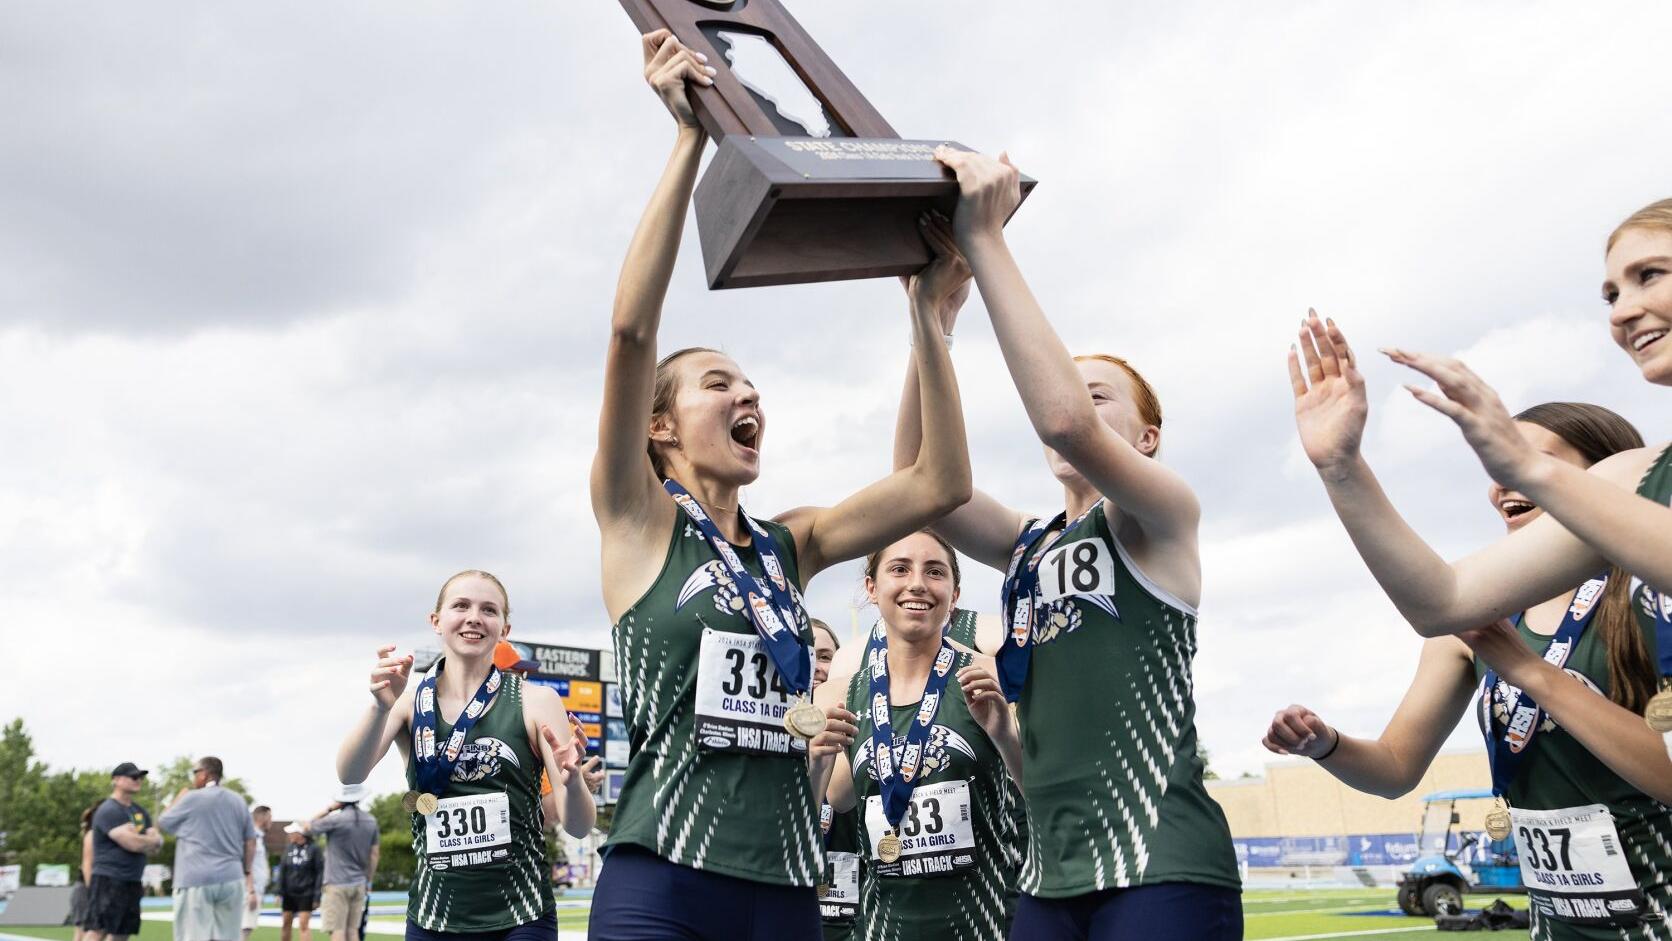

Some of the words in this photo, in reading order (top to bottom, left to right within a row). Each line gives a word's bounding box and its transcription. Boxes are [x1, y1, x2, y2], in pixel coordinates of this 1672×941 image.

[784, 141, 842, 151] STATE
[1050, 541, 1100, 595] 18
[750, 597, 785, 635] IHSA
[535, 647, 590, 665] EASTERN
[722, 648, 788, 702] 334
[722, 698, 756, 714] CLASS
[759, 703, 771, 717] 1A
[737, 726, 763, 750] IHSA
[762, 730, 790, 754] TRACK
[944, 787, 956, 795] MEET
[436, 805, 487, 838] 330
[884, 797, 943, 837] 33
[440, 838, 461, 848] CLASS
[464, 836, 473, 845] 1A
[474, 834, 495, 844] GIRLS
[916, 836, 927, 848] 1A
[929, 834, 956, 846] GIRLS
[1519, 826, 1574, 872] 337
[451, 853, 469, 867] IHSA
[468, 850, 493, 865] TRACK
[902, 858, 923, 876] IHSA
[922, 855, 953, 873] TRACK
[1557, 874, 1570, 886] 1A
[1572, 872, 1604, 886] GIRLS
[1570, 898, 1611, 918] TRACK
